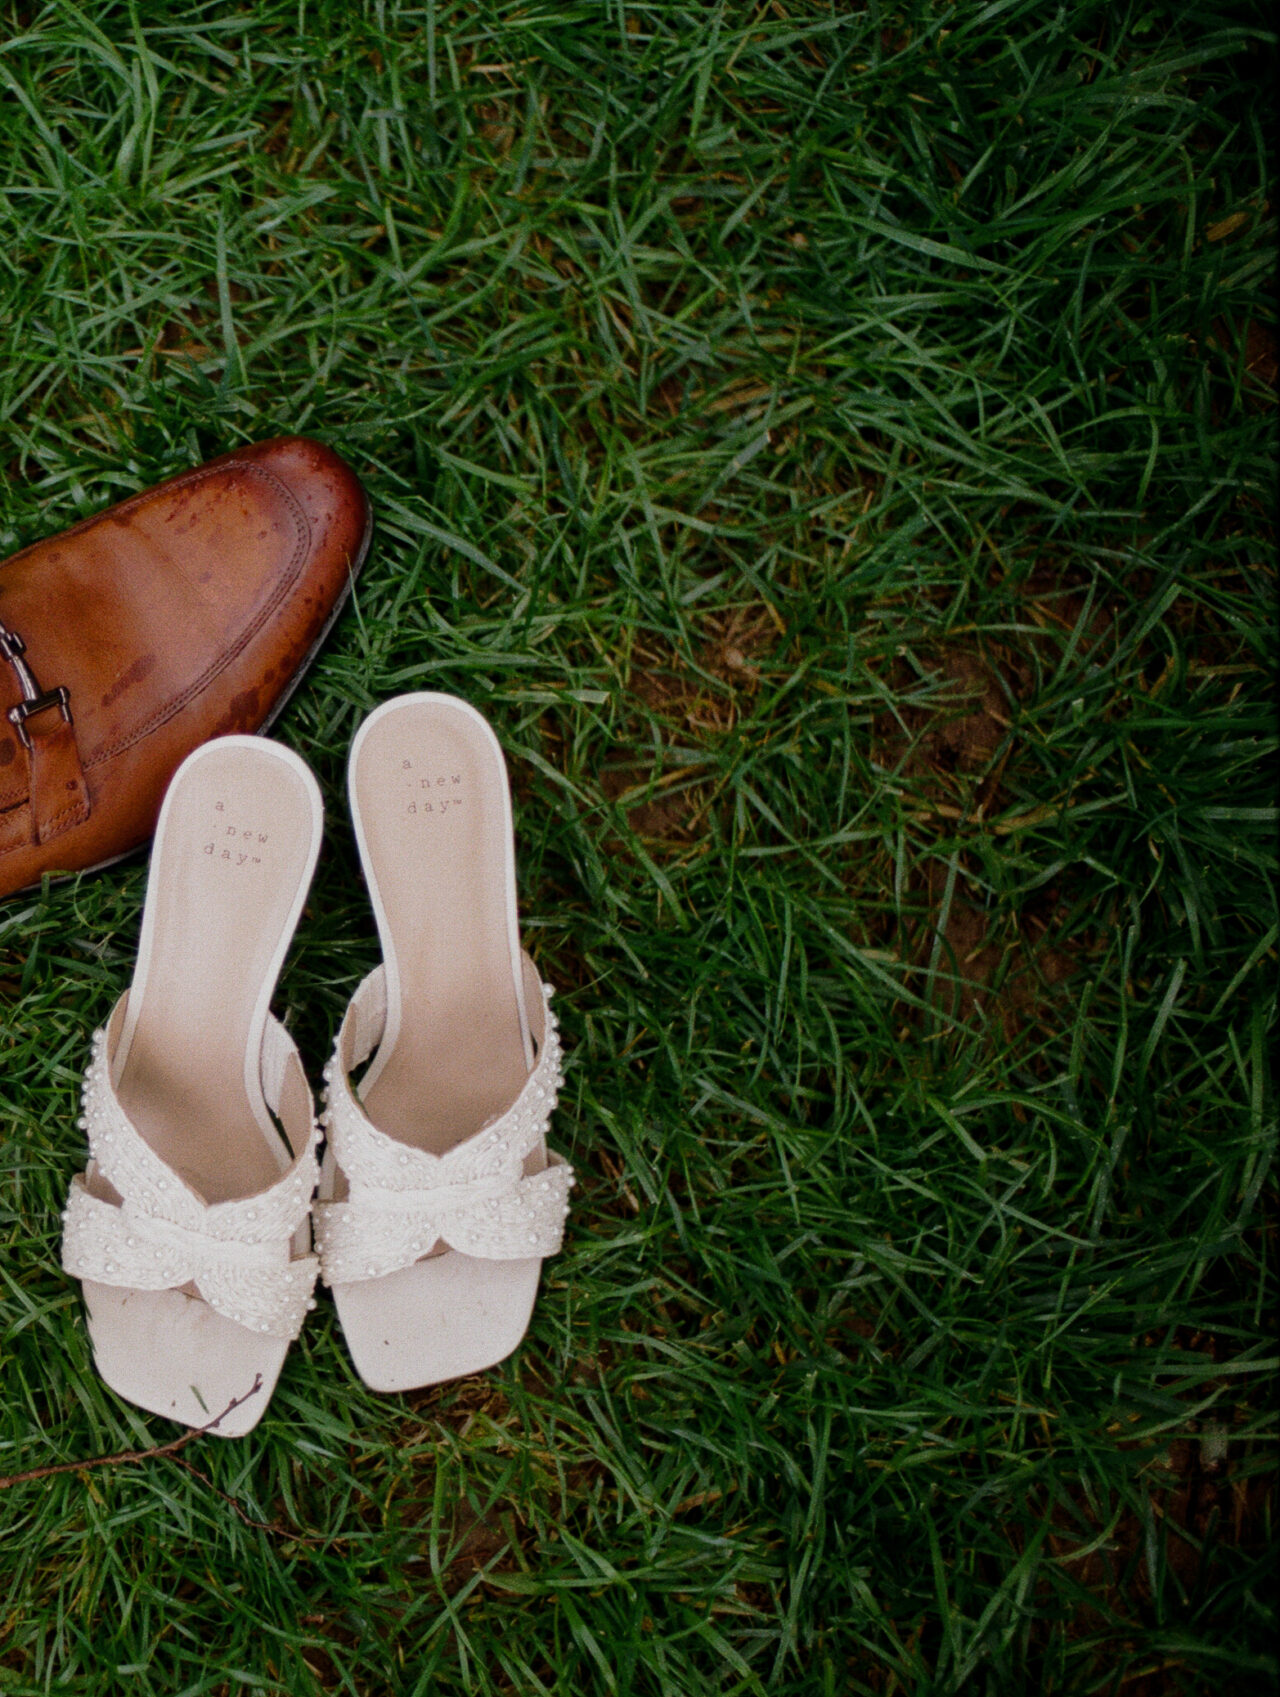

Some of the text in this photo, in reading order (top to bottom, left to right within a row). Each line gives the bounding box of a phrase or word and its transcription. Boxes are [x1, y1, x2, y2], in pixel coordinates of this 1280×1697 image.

[403, 760, 412, 769] a
[420, 775, 460, 788] new
[215, 801, 224, 811] a
[226, 826, 268, 843] new
